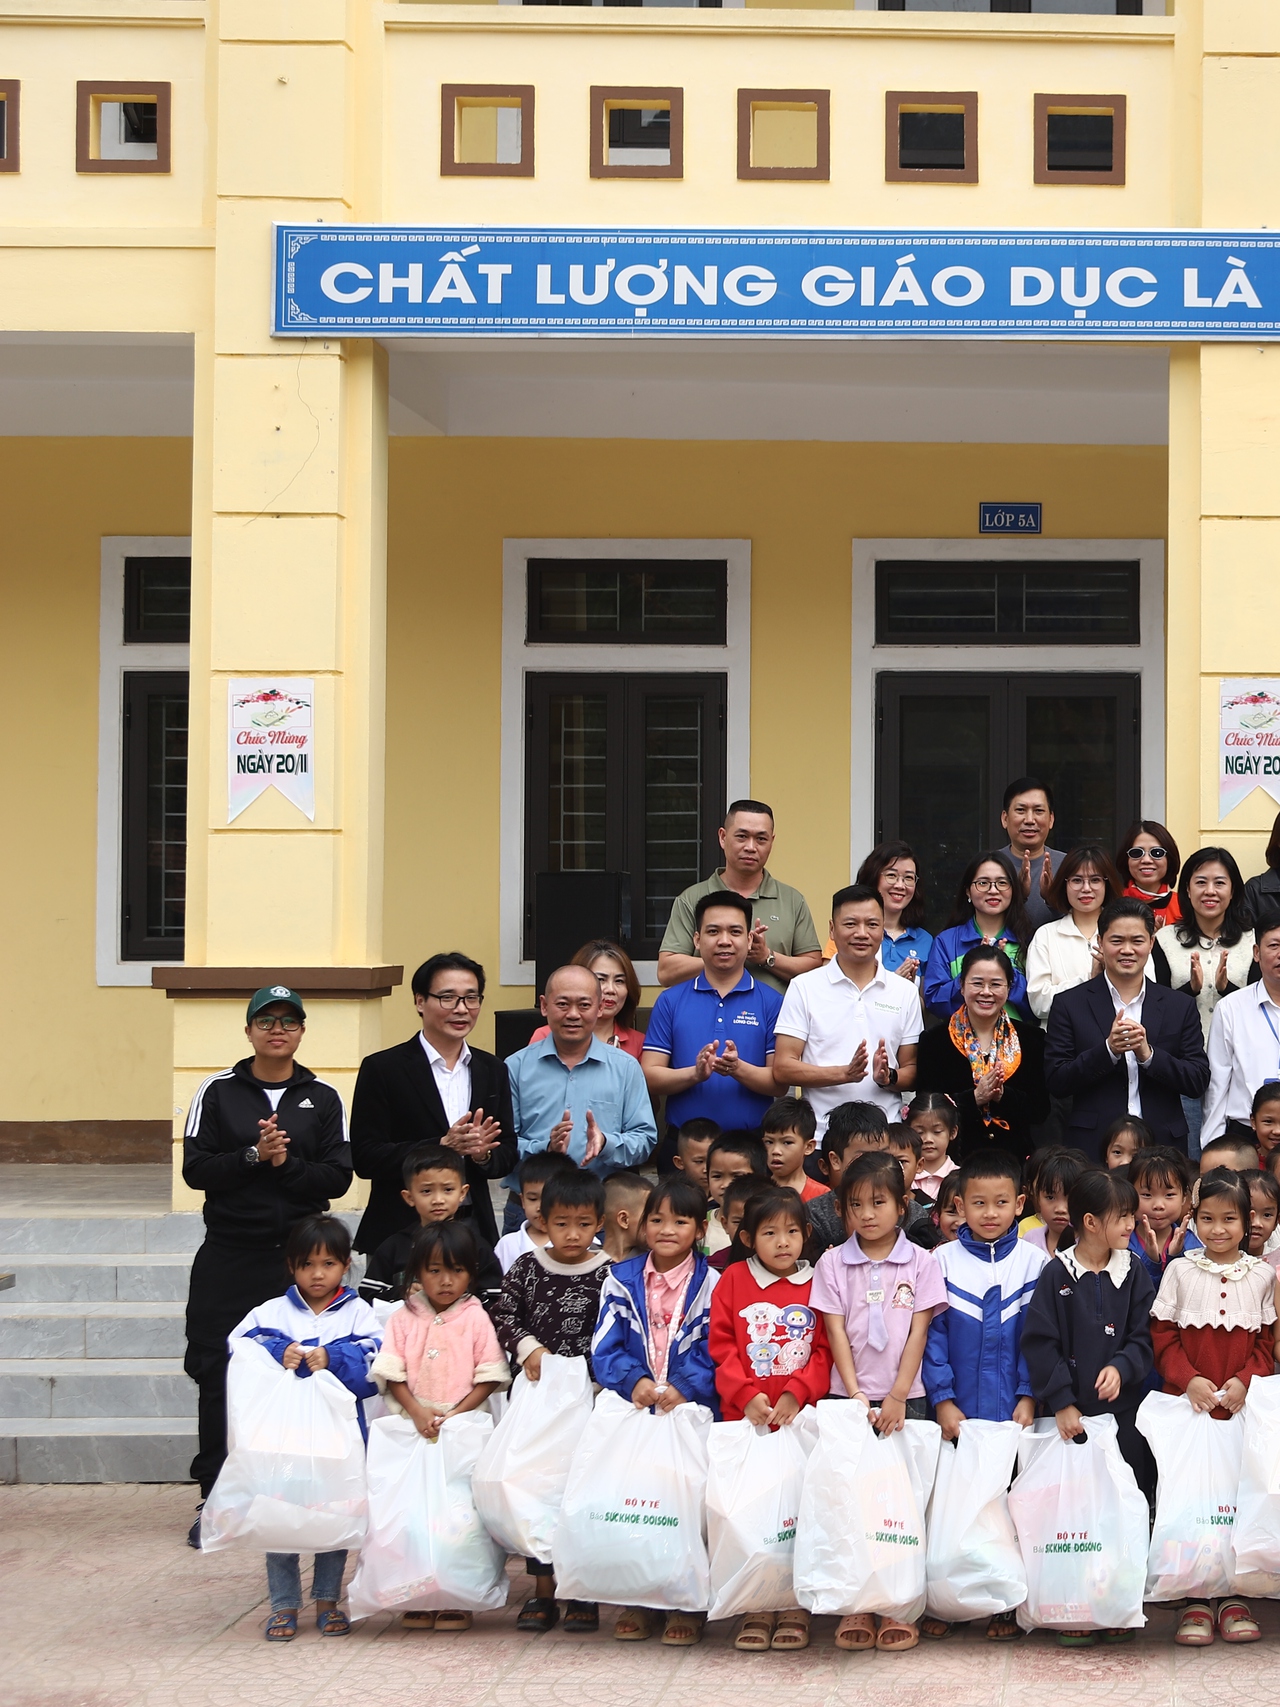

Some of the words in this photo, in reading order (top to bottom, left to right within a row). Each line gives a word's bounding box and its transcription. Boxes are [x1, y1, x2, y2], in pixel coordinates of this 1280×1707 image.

[321, 244, 504, 304] CHẤT
[537, 259, 777, 317] LƯỢNG
[802, 254, 984, 307] GIÁO
[1011, 267, 1158, 318] DỤC
[1184, 256, 1262, 308] LÀ
[985, 509, 1015, 527] LỚP
[1018, 514, 1036, 527] 5A
[237, 749, 274, 774] NGÀY
[276, 753, 309, 775] 20/11
[1225, 751, 1262, 775] NGÀY
[641, 1499, 646, 1507] Y
[1057, 1531, 1068, 1542] BỘ
[1071, 1532, 1076, 1540] Y
